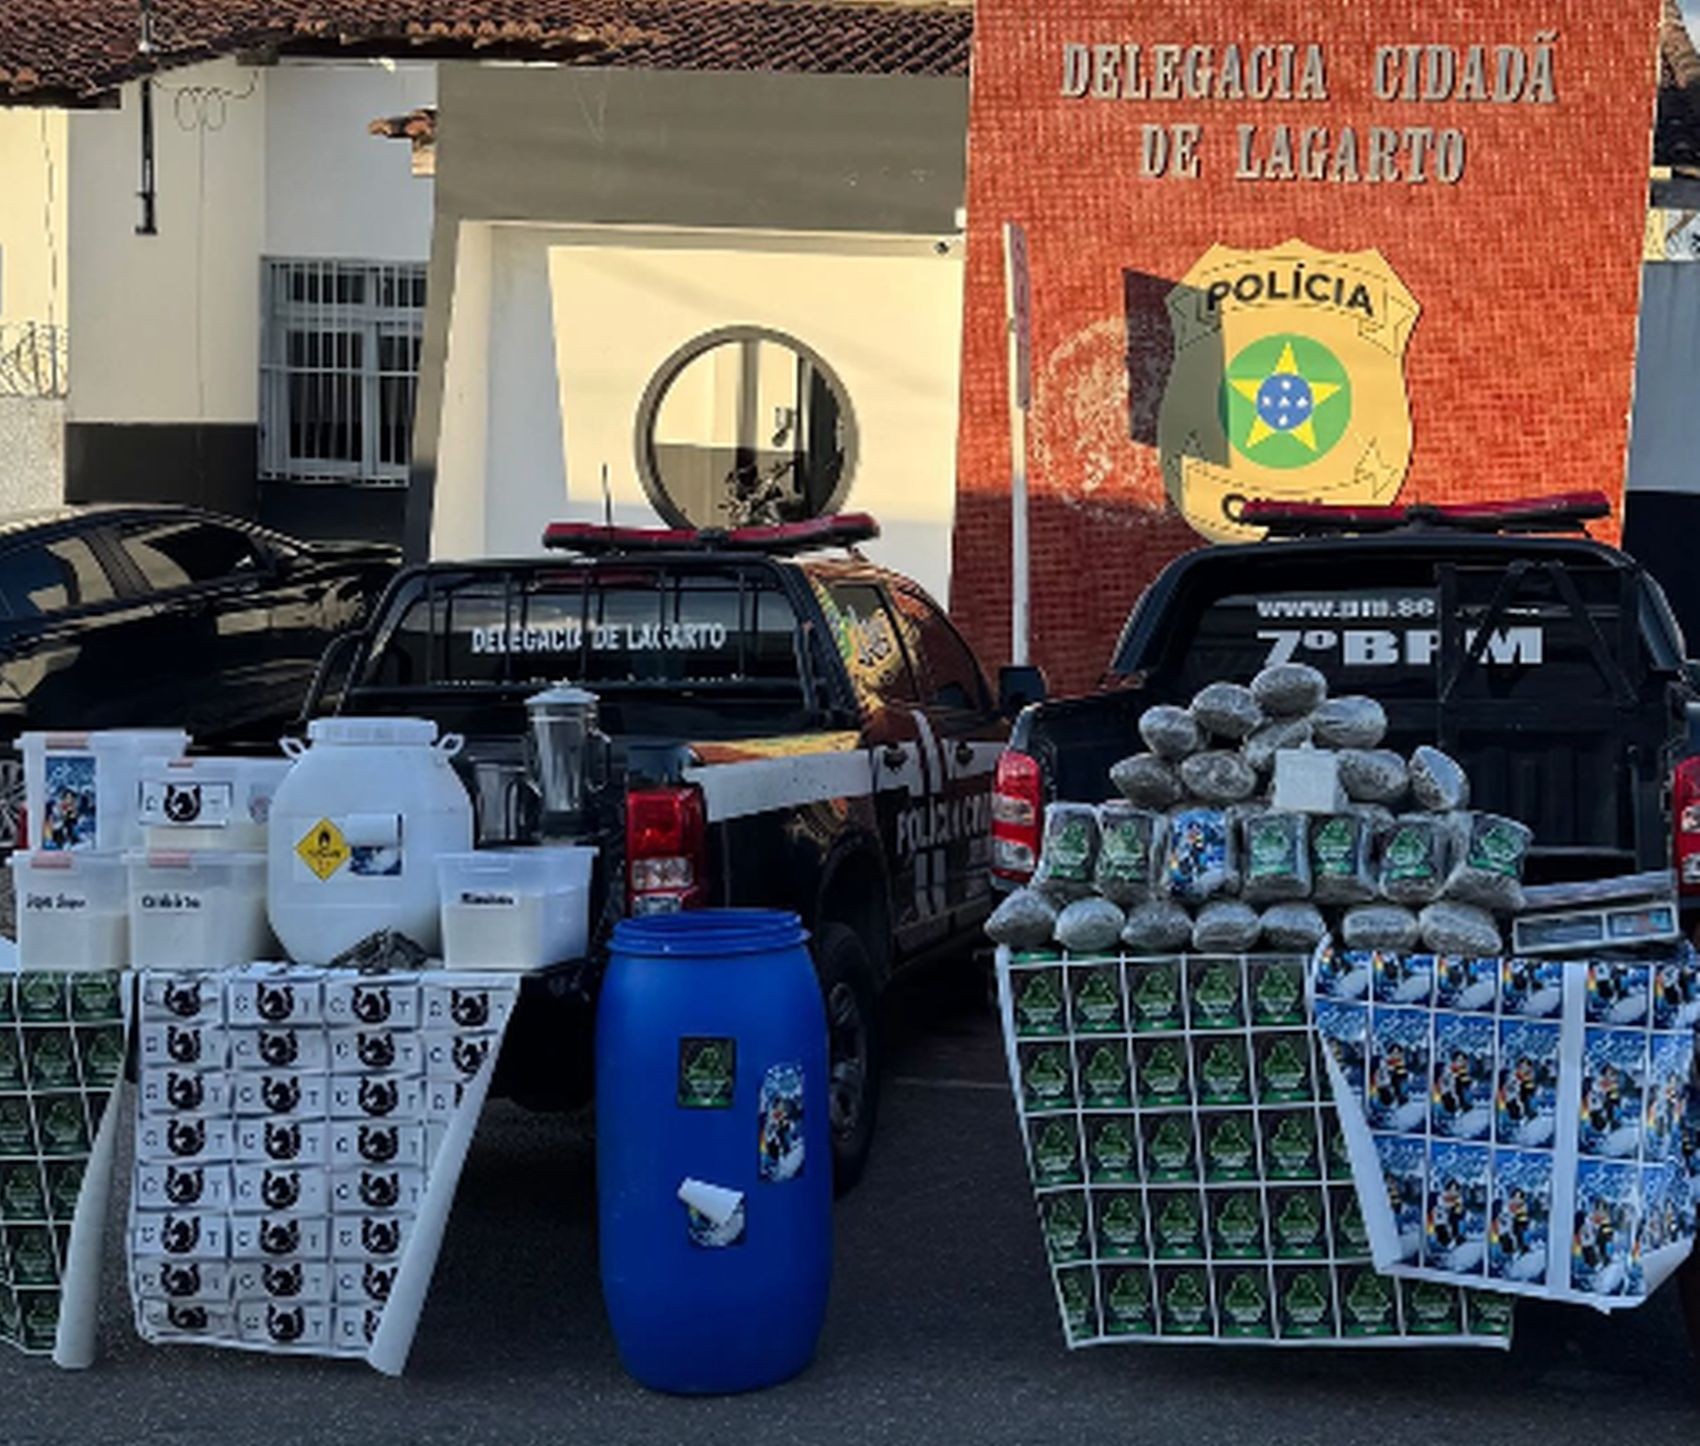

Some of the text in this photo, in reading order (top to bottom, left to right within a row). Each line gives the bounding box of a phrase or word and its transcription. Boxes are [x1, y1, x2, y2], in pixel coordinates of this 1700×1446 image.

[1061, 29, 1561, 104] DELEGACIA CIDADÃ
[1140, 123, 1468, 184] DE LAGARTO
[1207, 262, 1374, 318] POLÍCIA
[471, 627, 582, 652] DELEGACIA
[592, 627, 620, 650] DE
